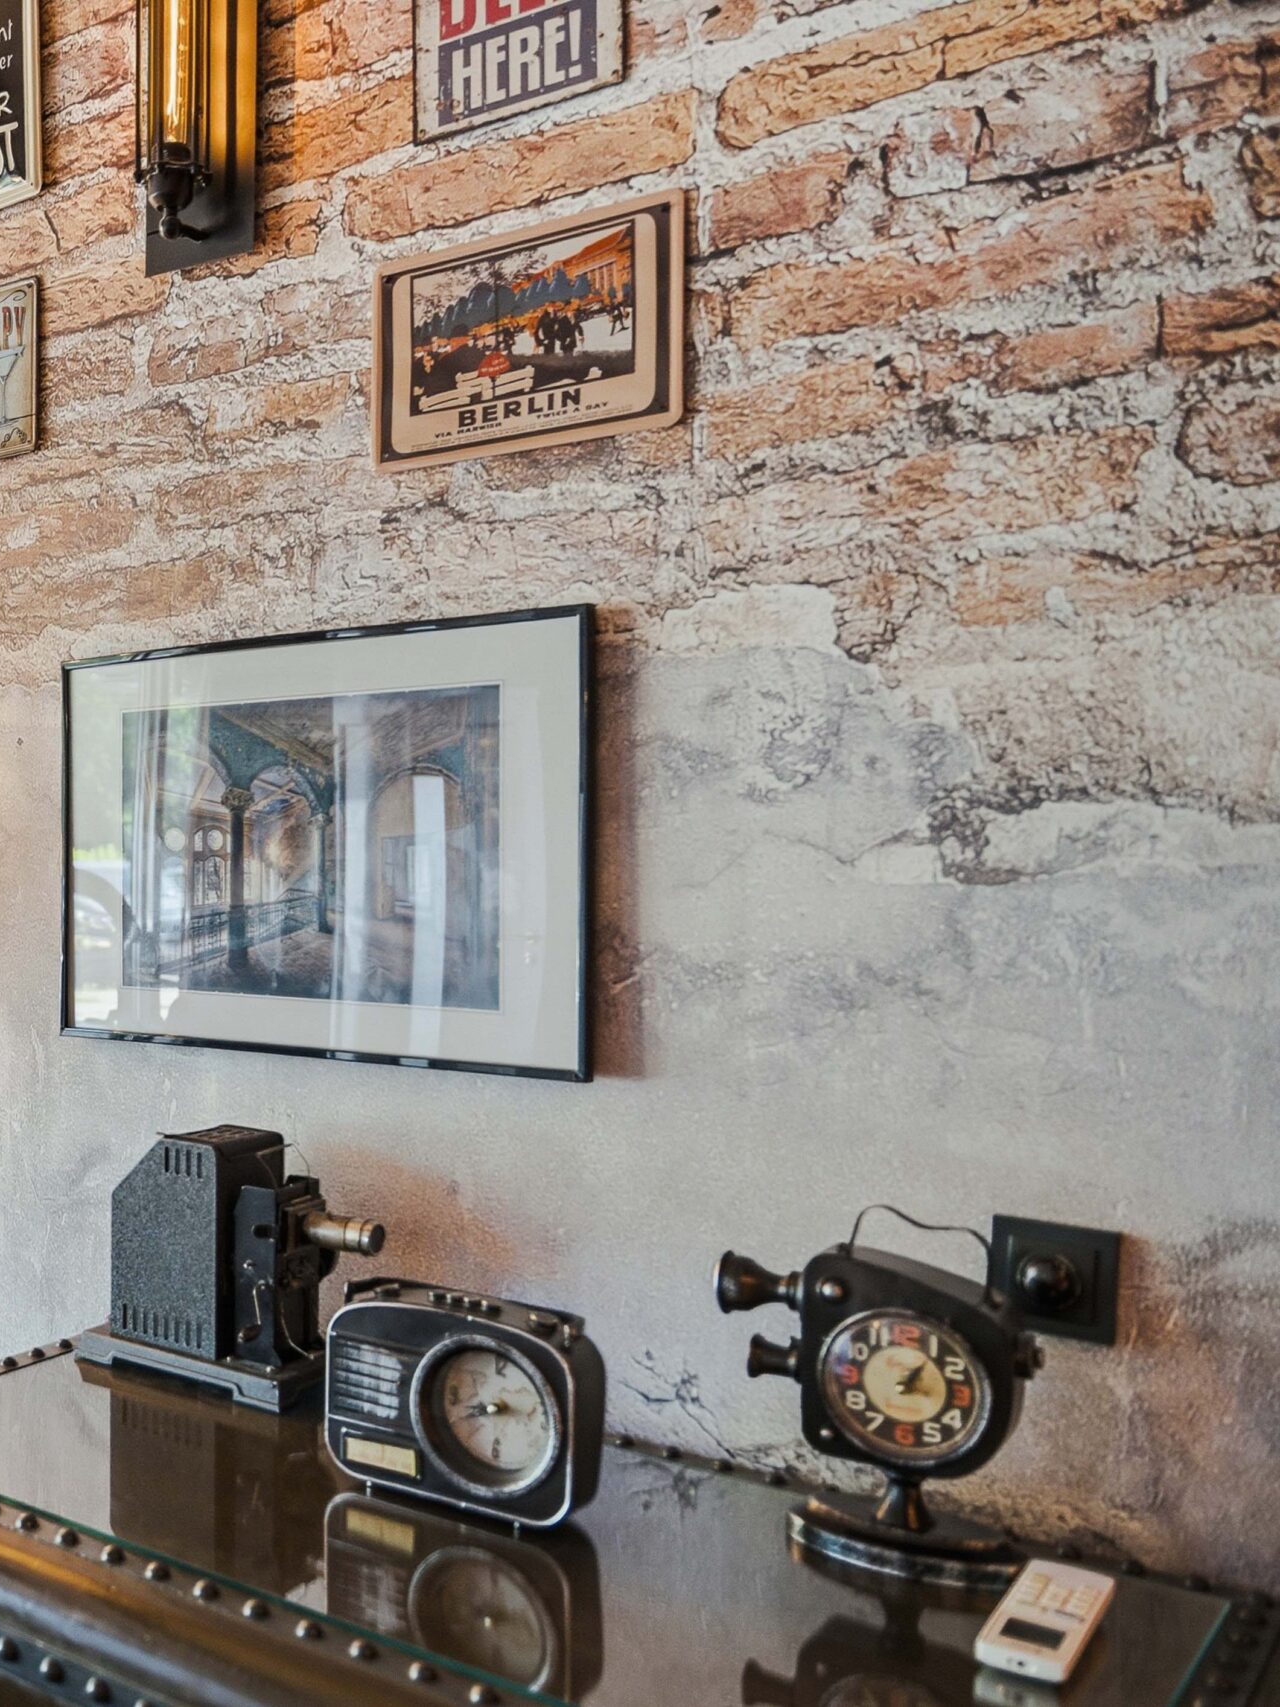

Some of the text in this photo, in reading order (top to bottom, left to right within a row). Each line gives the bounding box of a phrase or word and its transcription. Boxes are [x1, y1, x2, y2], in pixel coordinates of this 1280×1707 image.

[452, 9, 582, 114] HERE!
[458, 388, 581, 428] BERLIN
[929, 1335, 938, 1358] 1
[944, 1357, 966, 1381] 2
[845, 1390, 866, 1410] 8
[953, 1384, 971, 1408] 3
[864, 1411, 885, 1431] 7
[941, 1408, 963, 1430] 4
[894, 1424, 915, 1445] 6
[922, 1422, 942, 1443] 5
